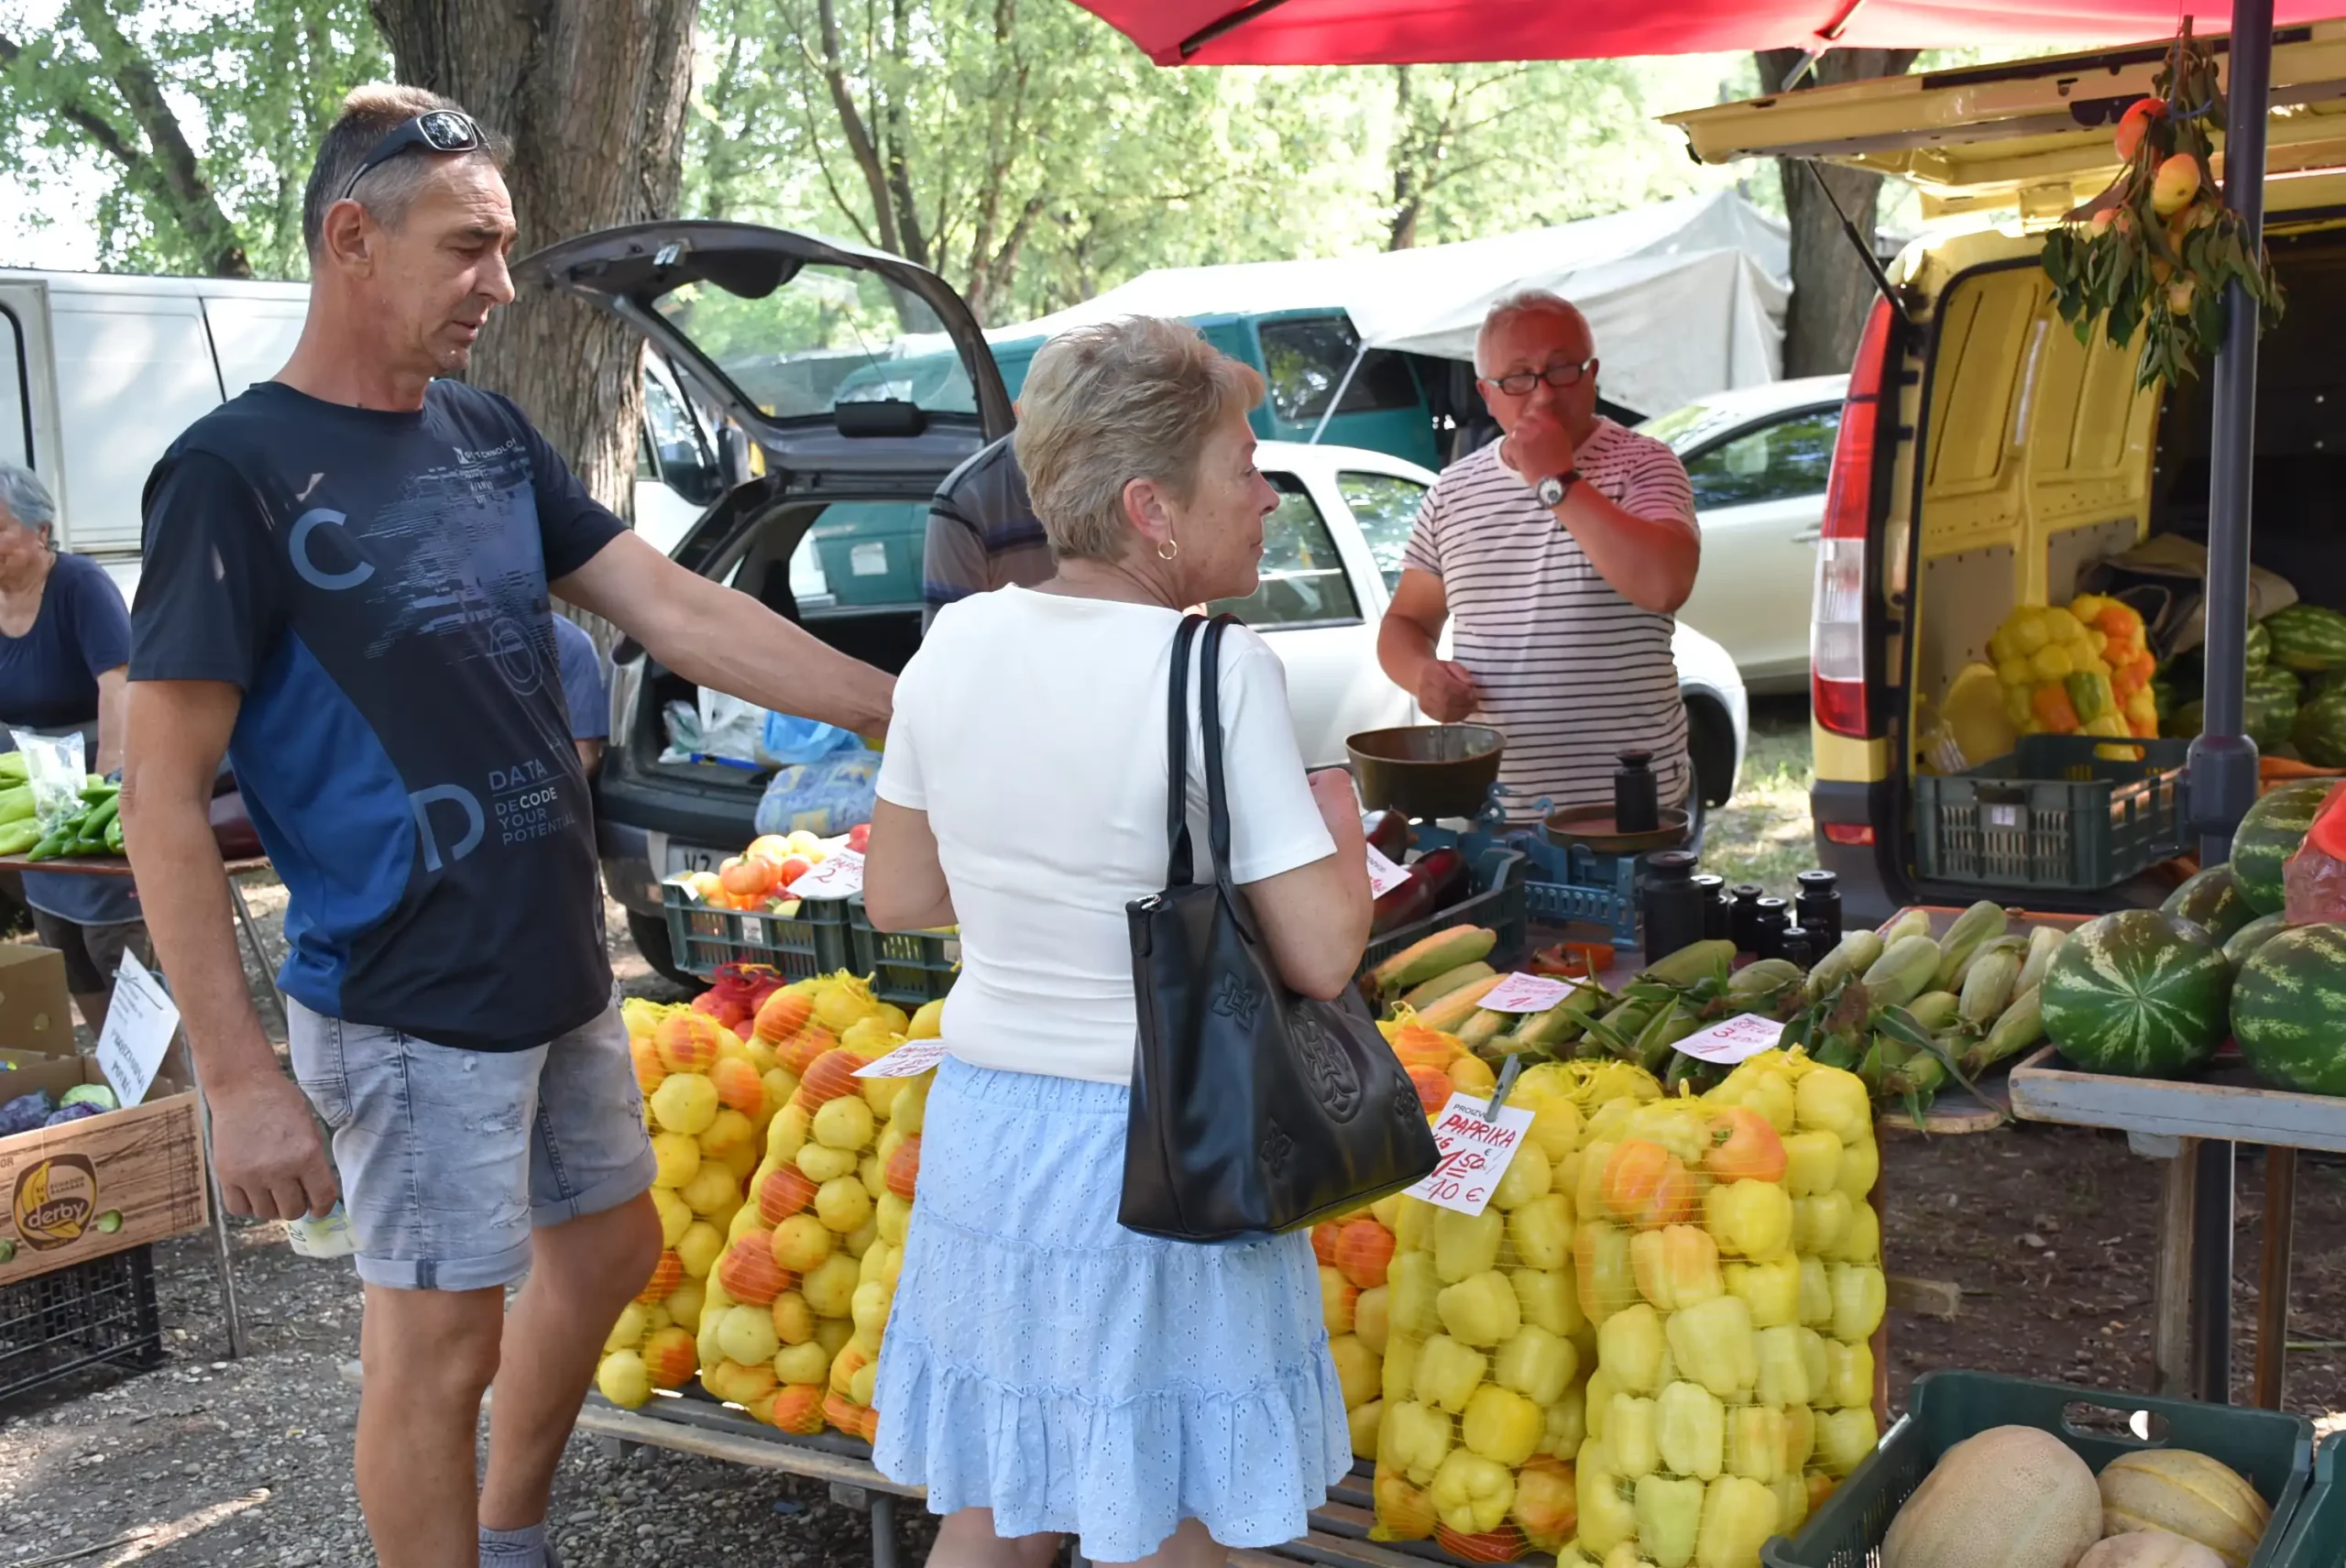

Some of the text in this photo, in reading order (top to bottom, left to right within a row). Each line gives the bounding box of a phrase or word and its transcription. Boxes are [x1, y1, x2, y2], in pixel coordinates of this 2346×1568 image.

[289, 508, 375, 590] C
[488, 759, 548, 790] DATA
[495, 787, 557, 816] DECODE
[499, 807, 547, 830] YOUR
[502, 812, 576, 845] POTENTIAL
[810, 868, 836, 883] 2
[1713, 1026, 1734, 1037] 3
[1453, 1103, 1488, 1120] PROIZV
[1438, 1113, 1517, 1148] PAPRIKA
[1428, 1179, 1485, 1202] 10 €
[27, 1201, 86, 1229] derby
